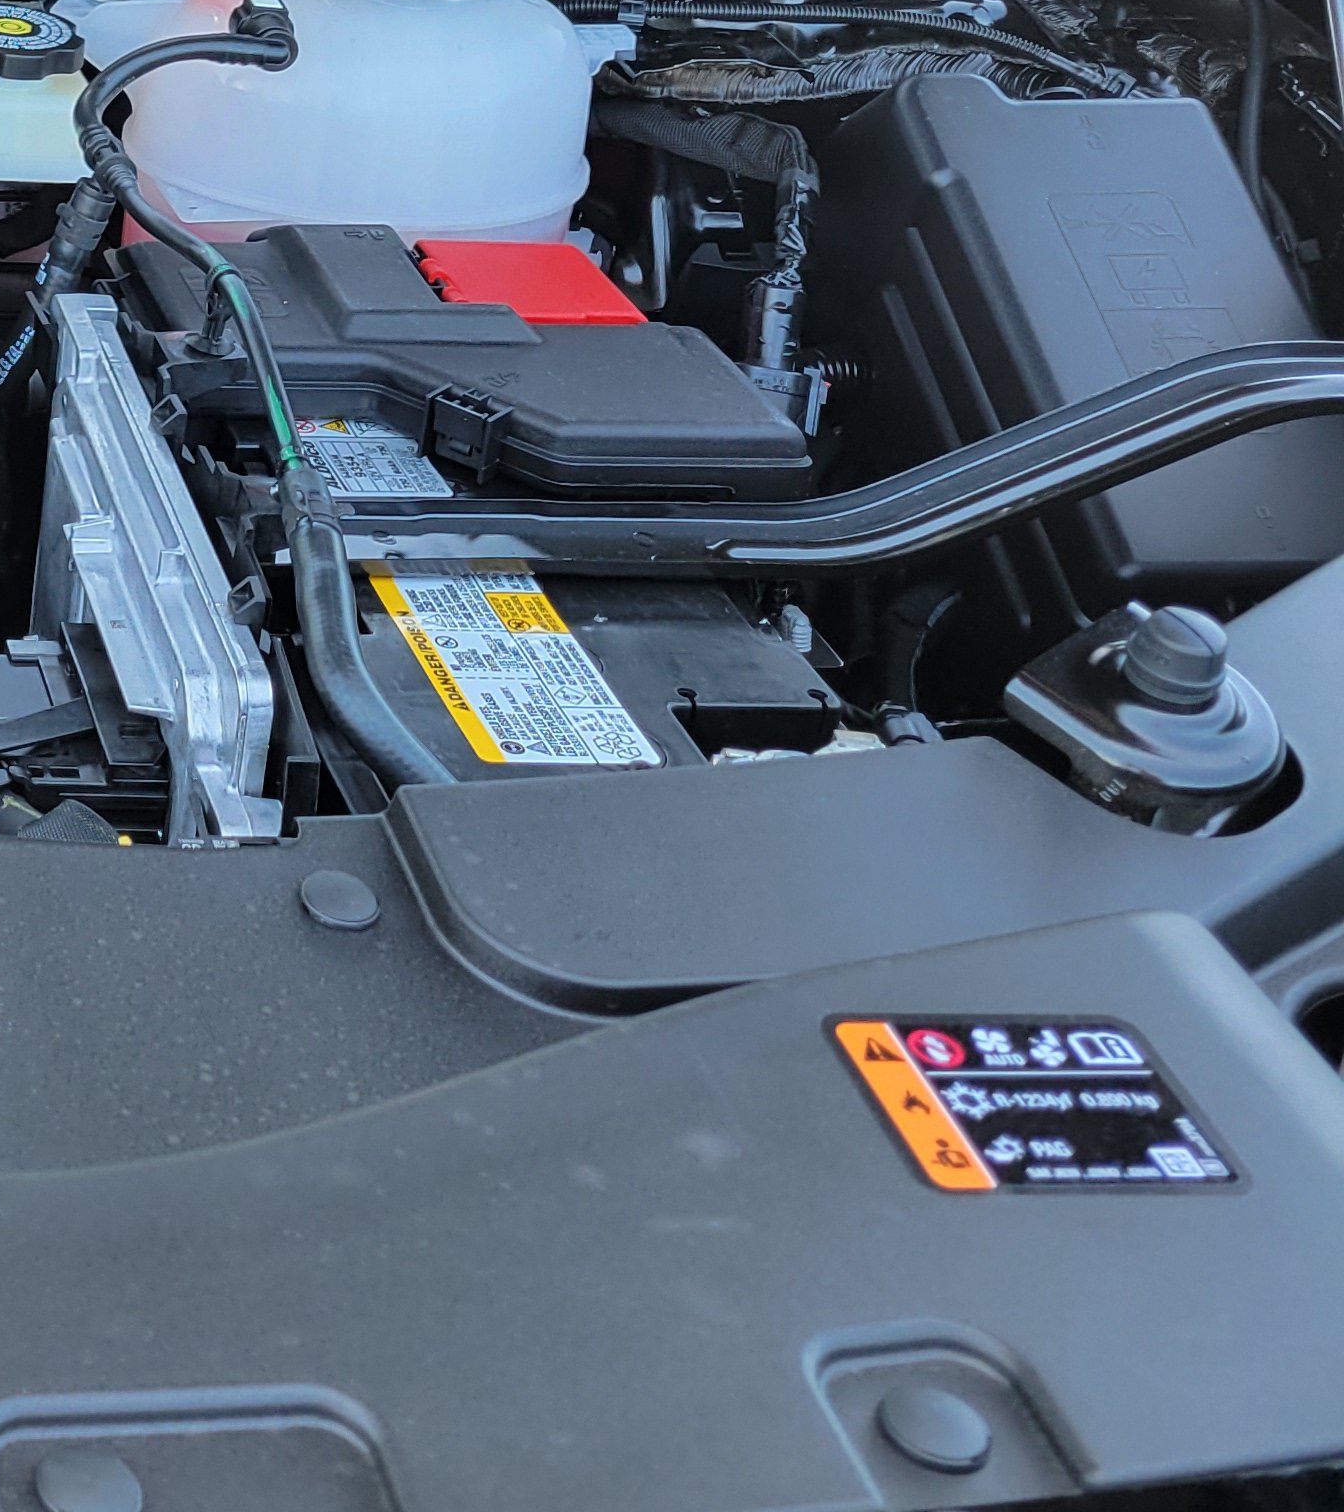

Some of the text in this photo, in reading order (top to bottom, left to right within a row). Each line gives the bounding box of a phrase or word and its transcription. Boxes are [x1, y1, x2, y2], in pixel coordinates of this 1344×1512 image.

[343, 456, 367, 478] 9354
[984, 1053, 1025, 1065] AUTO
[1029, 1141, 1074, 1157] PAG
